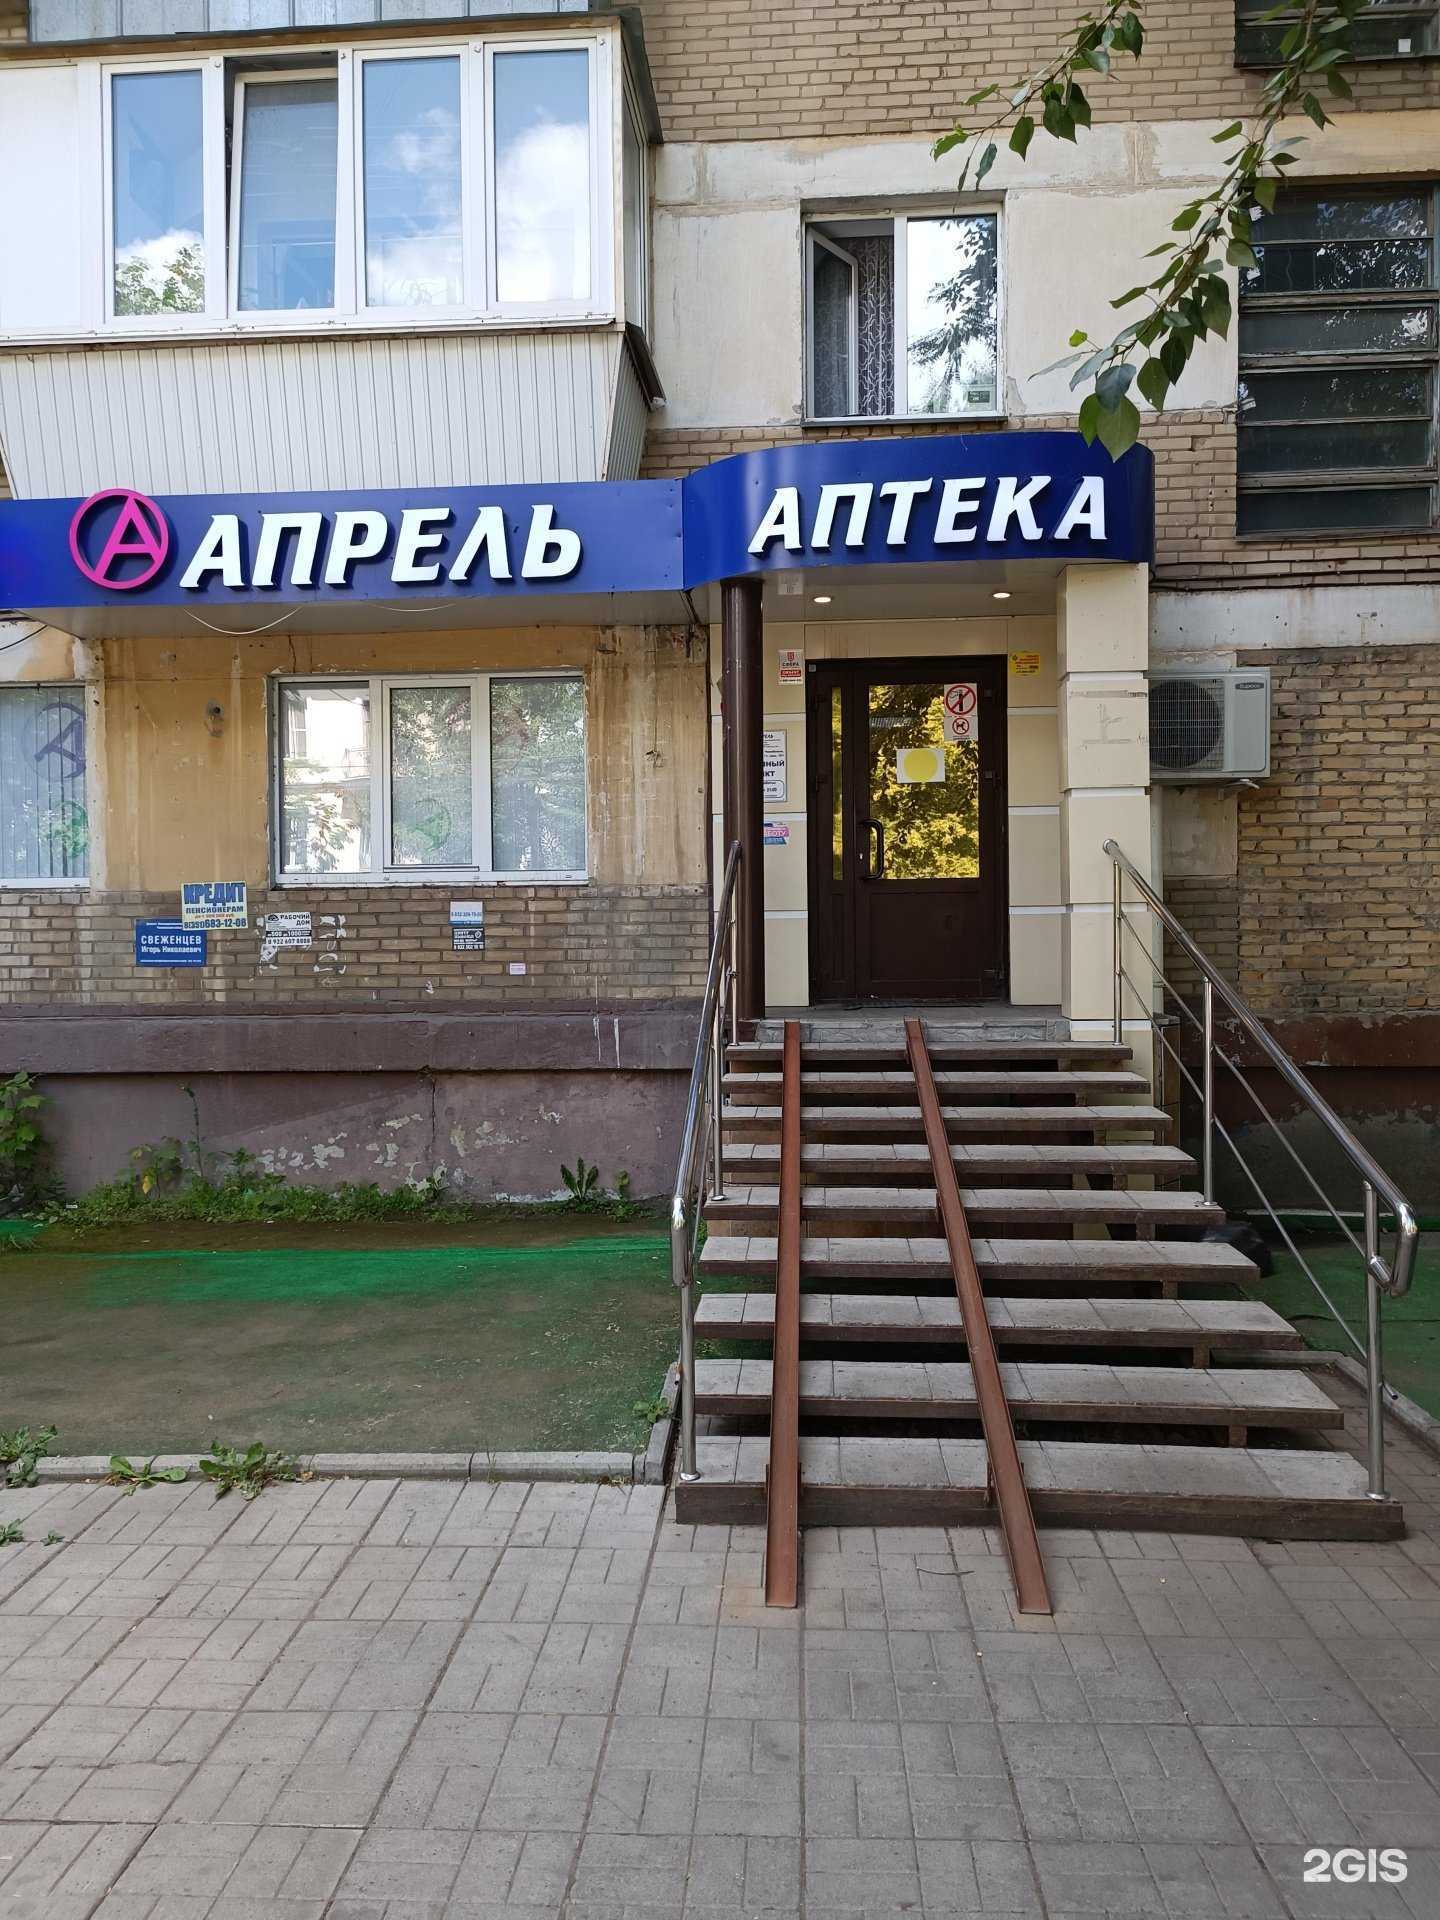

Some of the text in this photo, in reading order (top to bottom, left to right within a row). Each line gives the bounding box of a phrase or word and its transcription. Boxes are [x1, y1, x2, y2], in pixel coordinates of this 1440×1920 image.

[747, 476, 1108, 554] АПТЕКА
[179, 504, 582, 588] АПРЕЛЬ
[184, 883, 246, 906] КРЕДИТ
[185, 906, 244, 914] ПЕНСИОНЕРАМ
[140, 935, 202, 946] СВЕЖЕНЦЕВ
[141, 945, 202, 954] Игорь Николаевич
